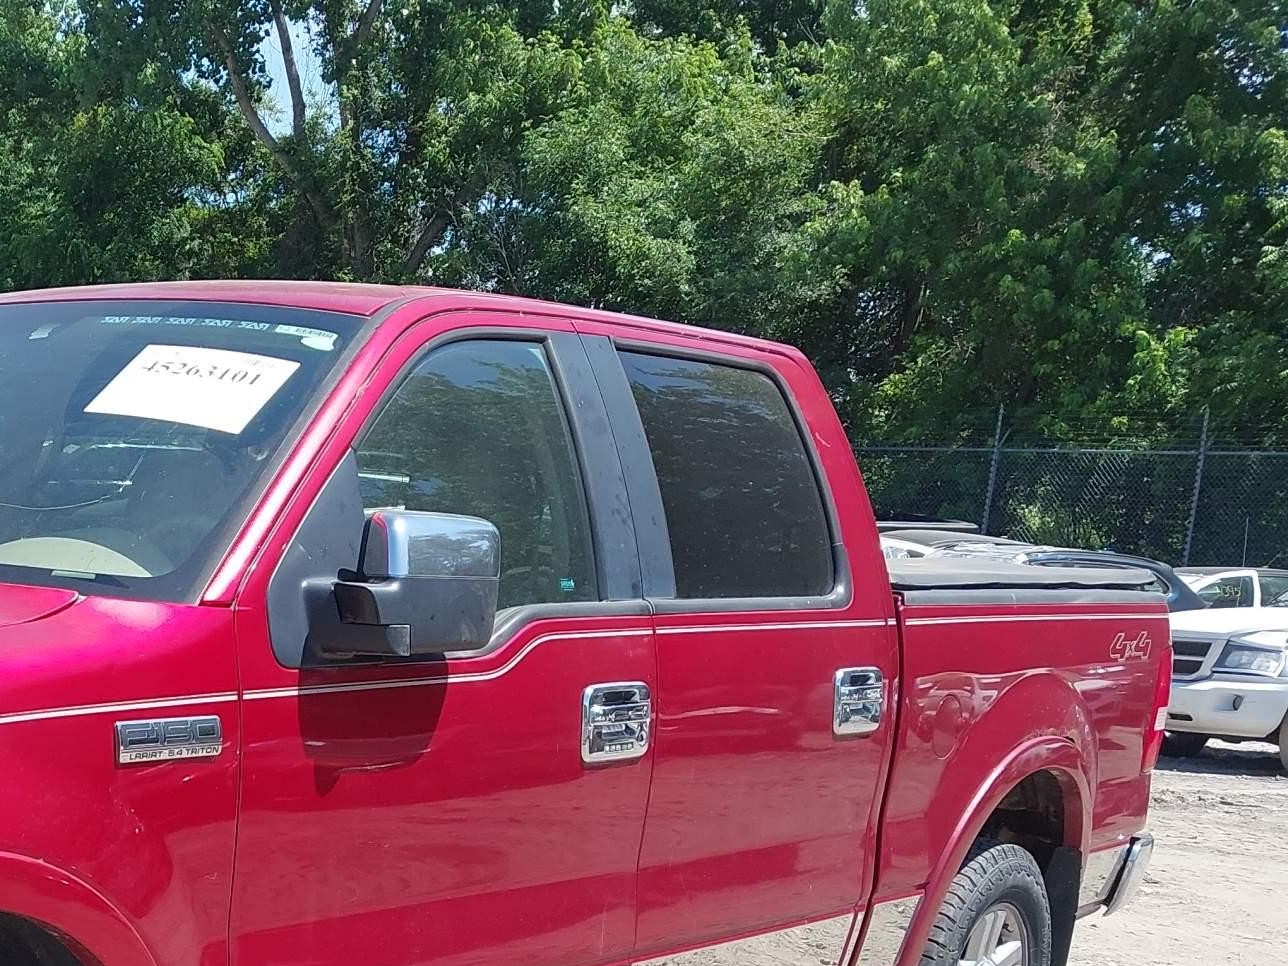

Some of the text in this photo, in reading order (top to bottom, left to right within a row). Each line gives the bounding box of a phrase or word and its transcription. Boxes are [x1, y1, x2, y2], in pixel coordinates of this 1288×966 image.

[142, 360, 262, 386] 45263101
[1110, 631, 1152, 662] 4x4
[129, 751, 163, 761] LARIAT
[184, 746, 220, 757] TRITON
